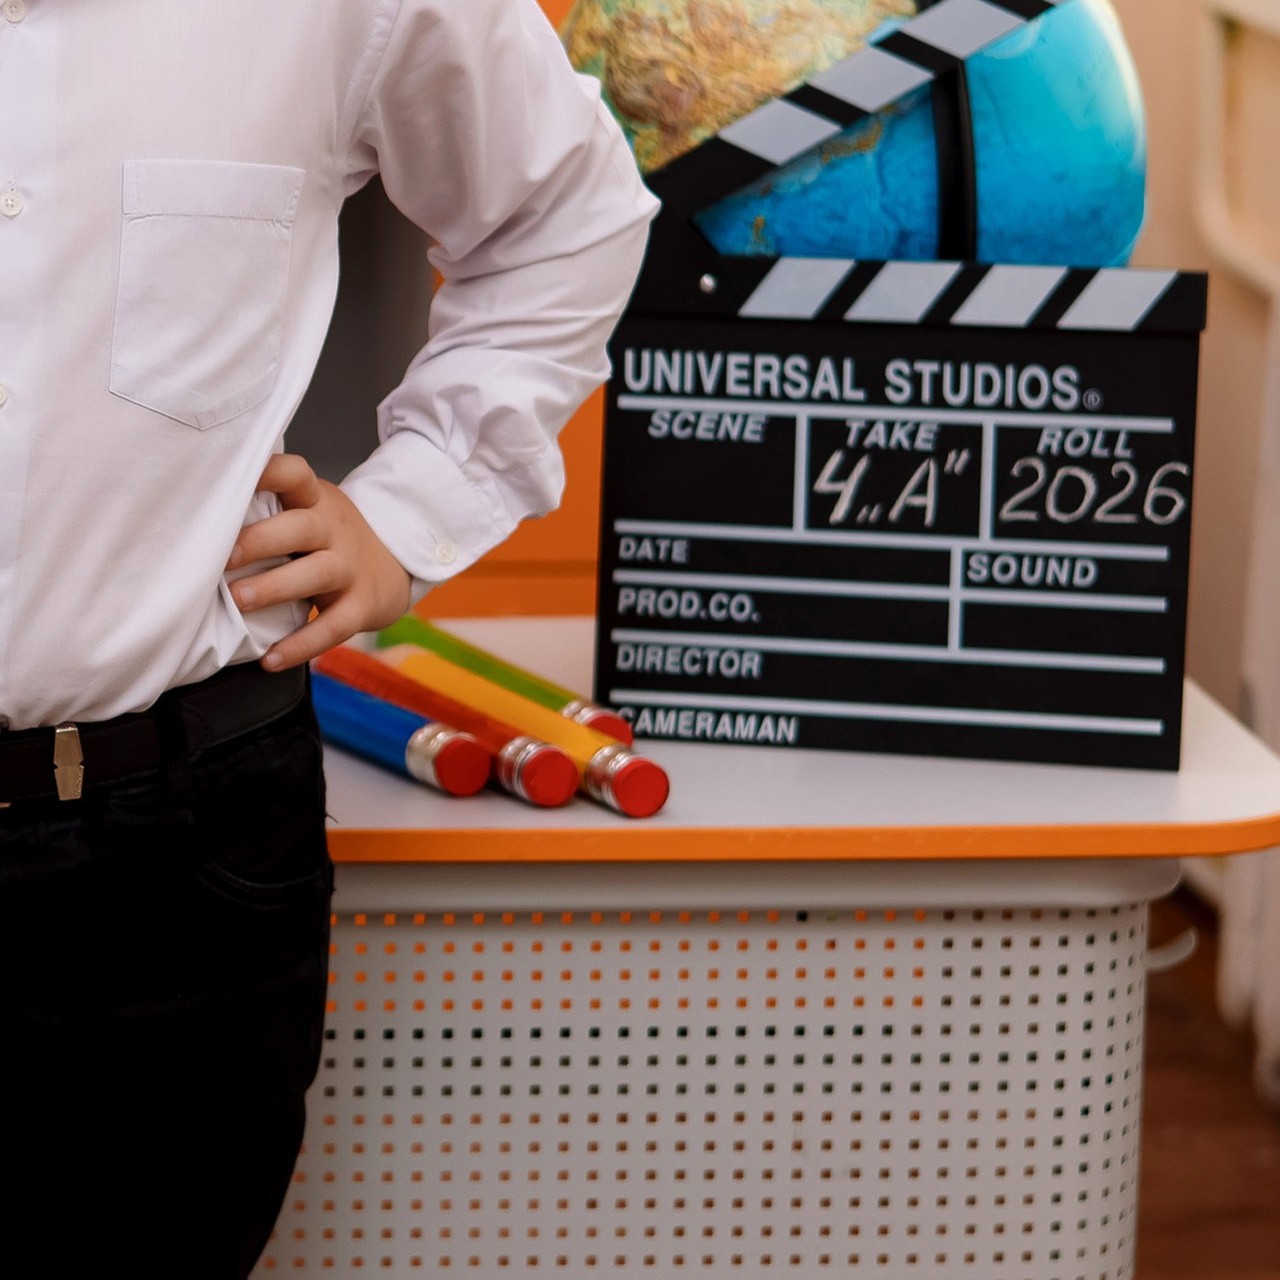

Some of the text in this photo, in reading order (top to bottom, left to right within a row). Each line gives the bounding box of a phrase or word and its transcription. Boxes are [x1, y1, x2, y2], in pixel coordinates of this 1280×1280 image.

[623, 347, 866, 401] UNIVERSAL
[647, 409, 767, 443] SCENE
[845, 417, 939, 451] TAKE
[1036, 427, 1134, 458] ROLL
[998, 456, 1190, 525] 2026
[618, 536, 690, 563] DATE
[966, 552, 1098, 587] SOUND
[617, 586, 761, 623] PROD.CO.
[616, 643, 762, 679] DIRECTOR
